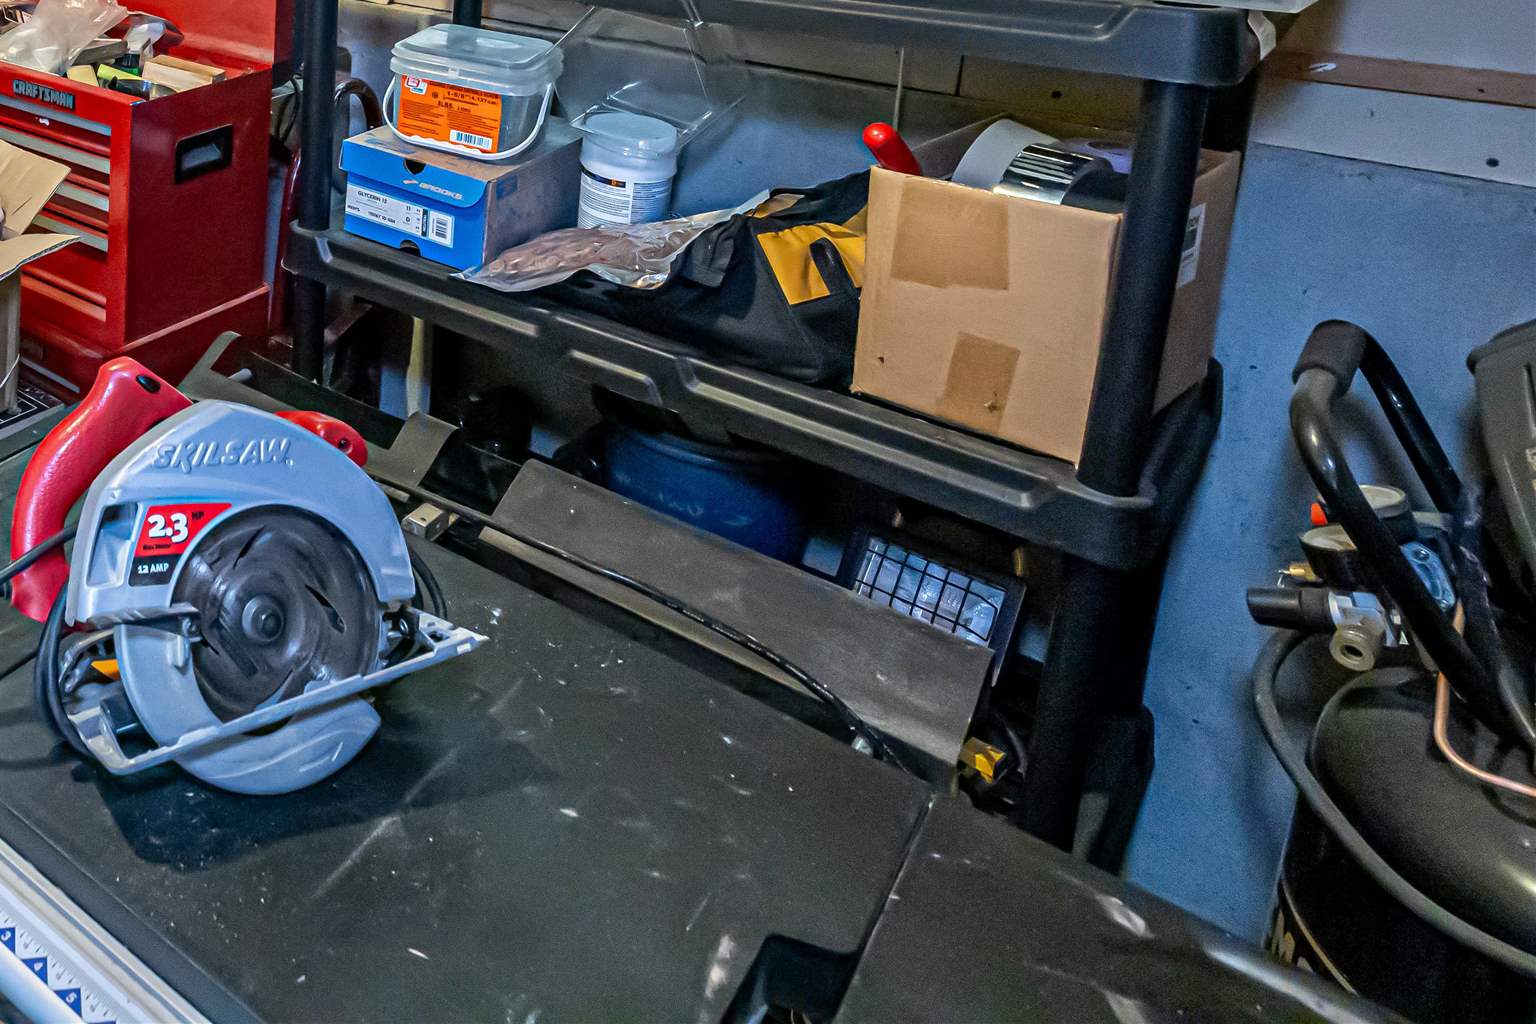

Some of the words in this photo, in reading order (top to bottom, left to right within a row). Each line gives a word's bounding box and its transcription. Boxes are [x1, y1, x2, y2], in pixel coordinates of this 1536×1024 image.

[13, 79, 74, 109] CRAFTSMAN
[419, 182, 463, 201] BROOKS
[154, 438, 292, 474] SKILSAW
[147, 512, 189, 543] 2.3
[191, 511, 205, 520] HP
[137, 565, 149, 574] 12
[150, 563, 169, 573] AMP
[1, 931, 12, 942] 3
[33, 962, 44, 972] 4
[66, 993, 77, 1004] 5
